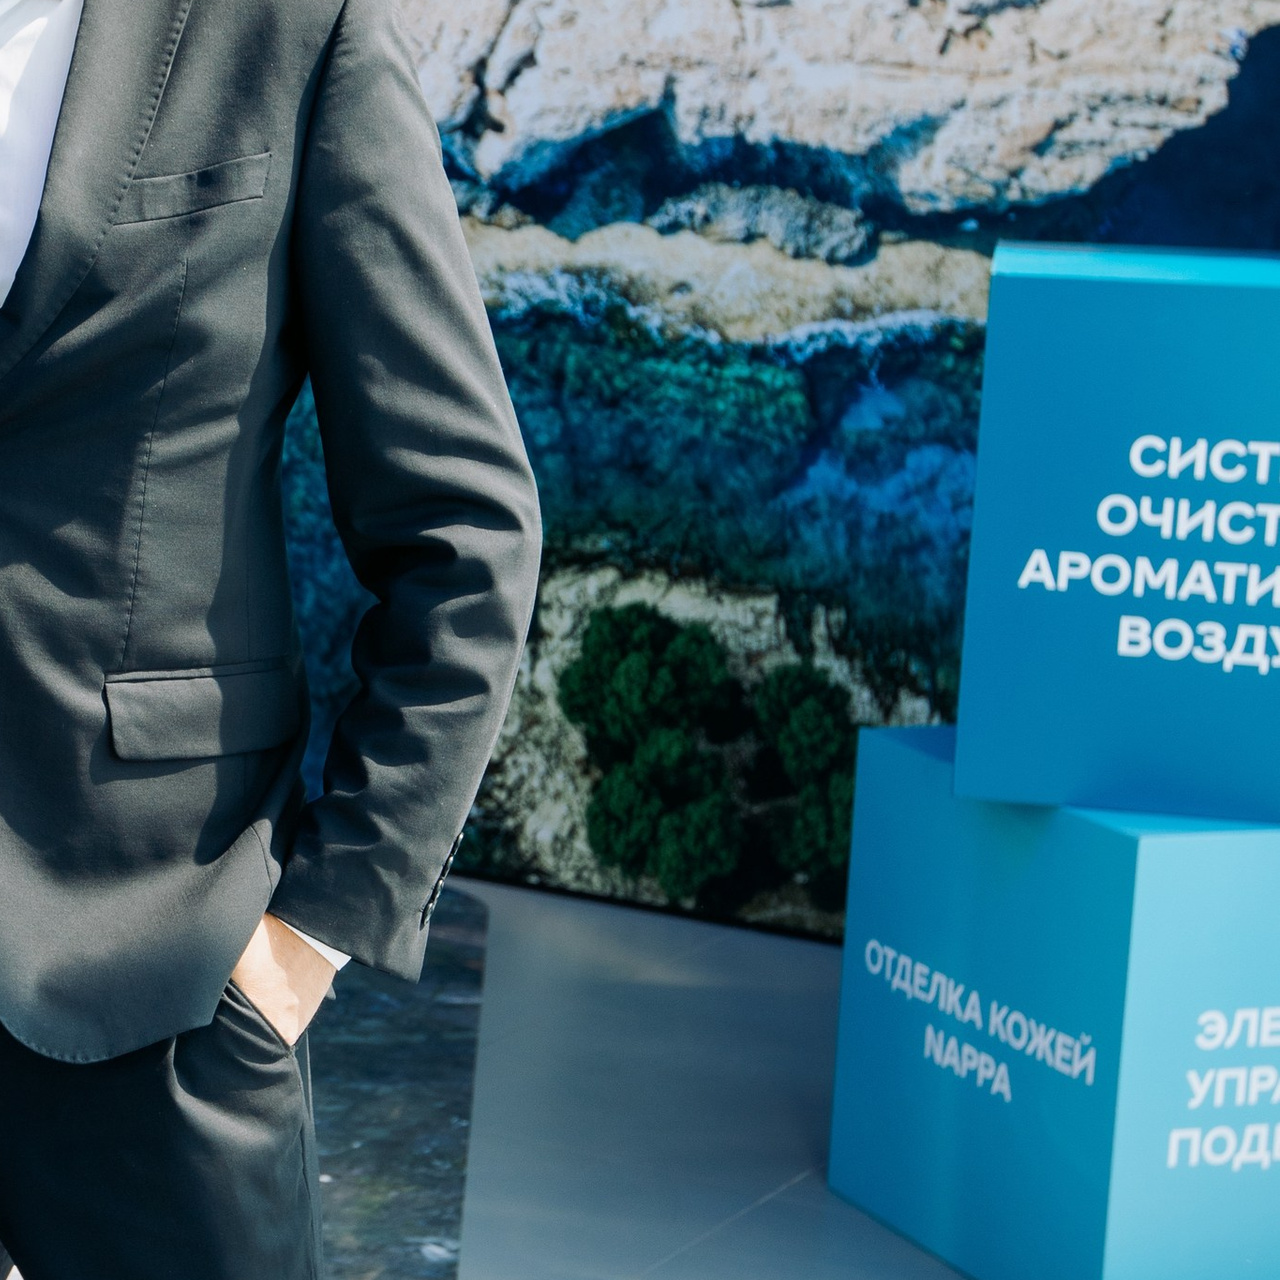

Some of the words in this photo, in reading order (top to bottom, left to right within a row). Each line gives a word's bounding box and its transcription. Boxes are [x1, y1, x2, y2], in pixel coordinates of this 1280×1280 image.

[1096, 493, 1280, 547] ОЧИСТ
[1018, 548, 1280, 609] АРОМАТИ
[865, 939, 984, 1030] ОТДЕЛКА
[989, 1000, 1097, 1086] КОЖЕЙ
[923, 1023, 1013, 1104] NAPPA
[1186, 1064, 1280, 1110] УПР
[1166, 1122, 1280, 1172] ПОД
